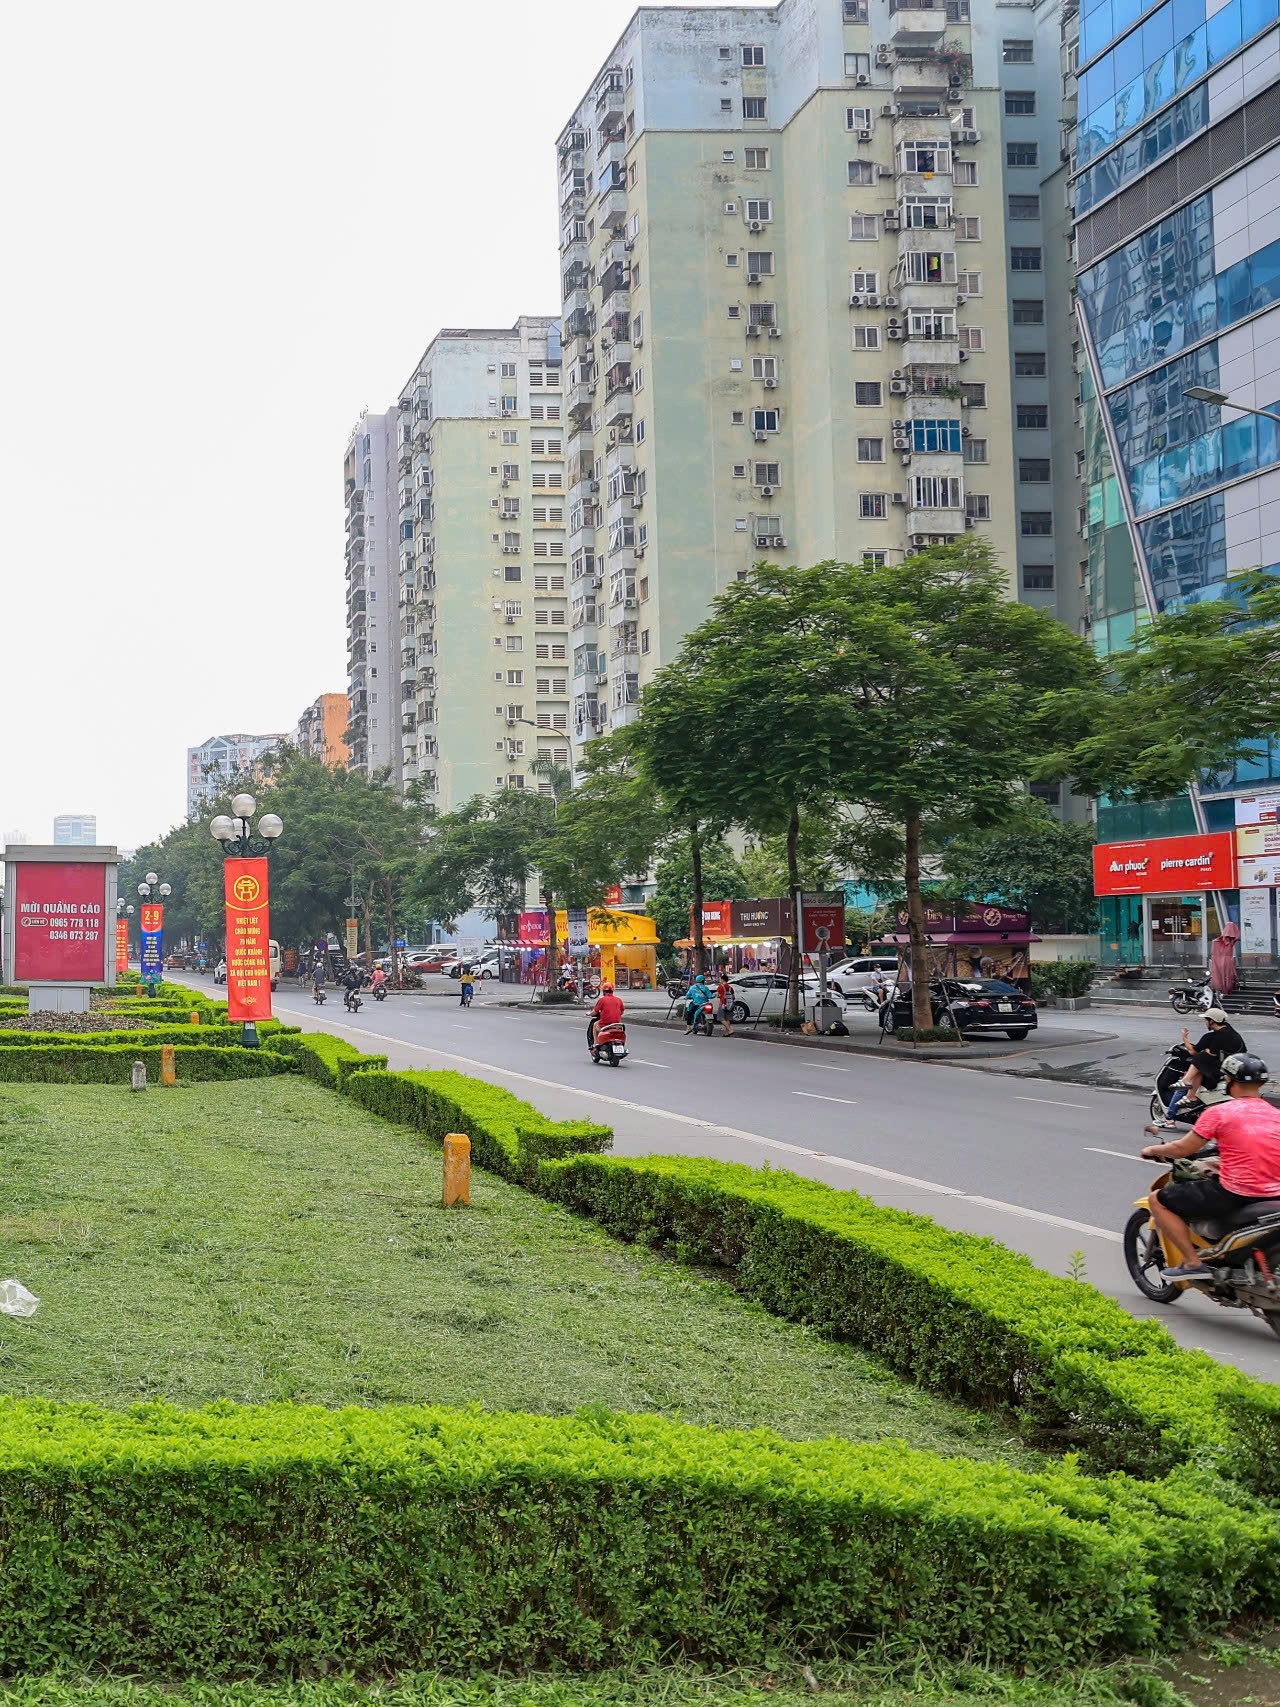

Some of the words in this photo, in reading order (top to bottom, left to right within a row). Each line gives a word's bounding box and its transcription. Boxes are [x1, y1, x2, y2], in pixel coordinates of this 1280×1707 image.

[1161, 858, 1183, 871] pierre
[1184, 855, 1210, 867] cardin
[21, 901, 40, 913] MỜI
[43, 901, 77, 914] QUẢNG
[80, 902, 100, 914] CÁO
[50, 918, 68, 927] 0965
[70, 918, 84, 928] 778
[85, 918, 99, 928] 118
[50, 931, 68, 940] 0346
[69, 931, 84, 940] 073
[85, 931, 99, 940] 287
